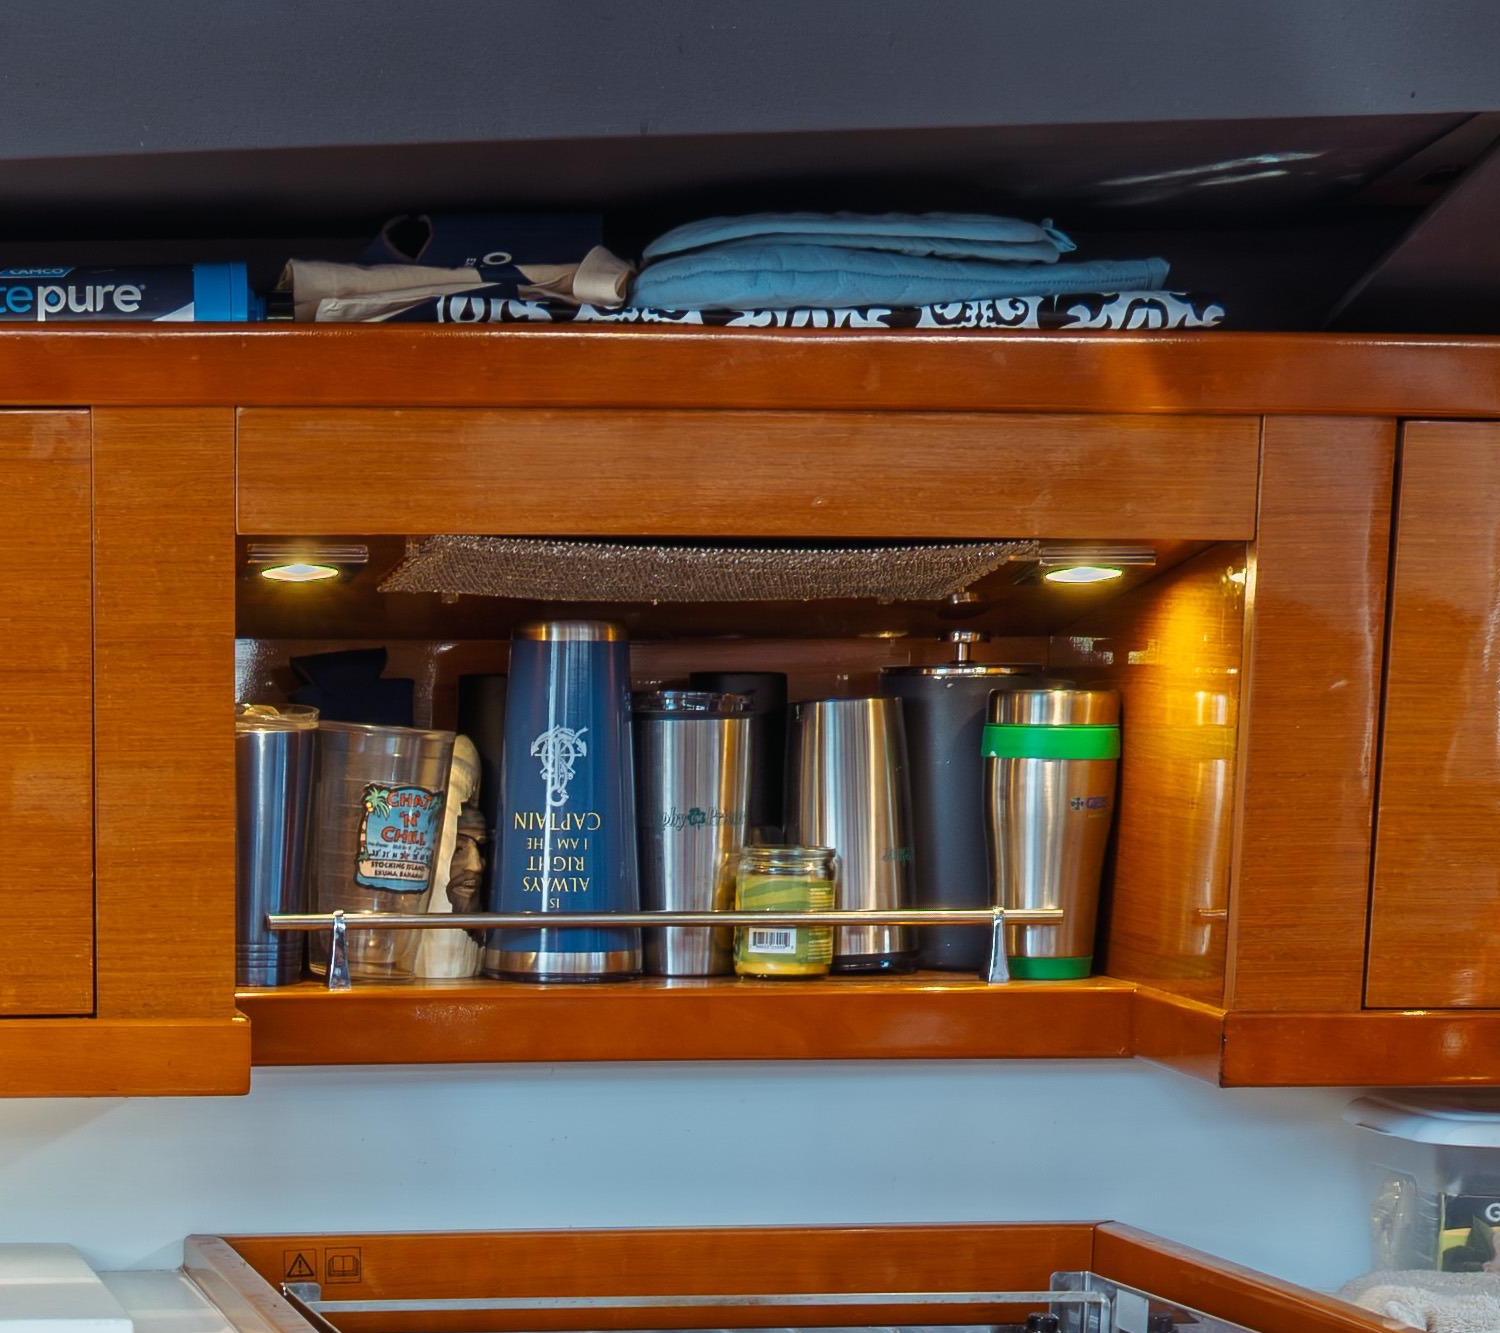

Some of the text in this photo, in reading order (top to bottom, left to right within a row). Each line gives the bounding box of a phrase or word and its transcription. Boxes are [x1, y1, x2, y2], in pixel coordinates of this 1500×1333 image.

[514, 811, 601, 831] CAPTAIN
[526, 837, 553, 851] HE
[556, 837, 580, 851] AM
[526, 856, 585, 872] RIGHT
[522, 876, 590, 893] ALWAYS
[549, 898, 560, 909] IS
